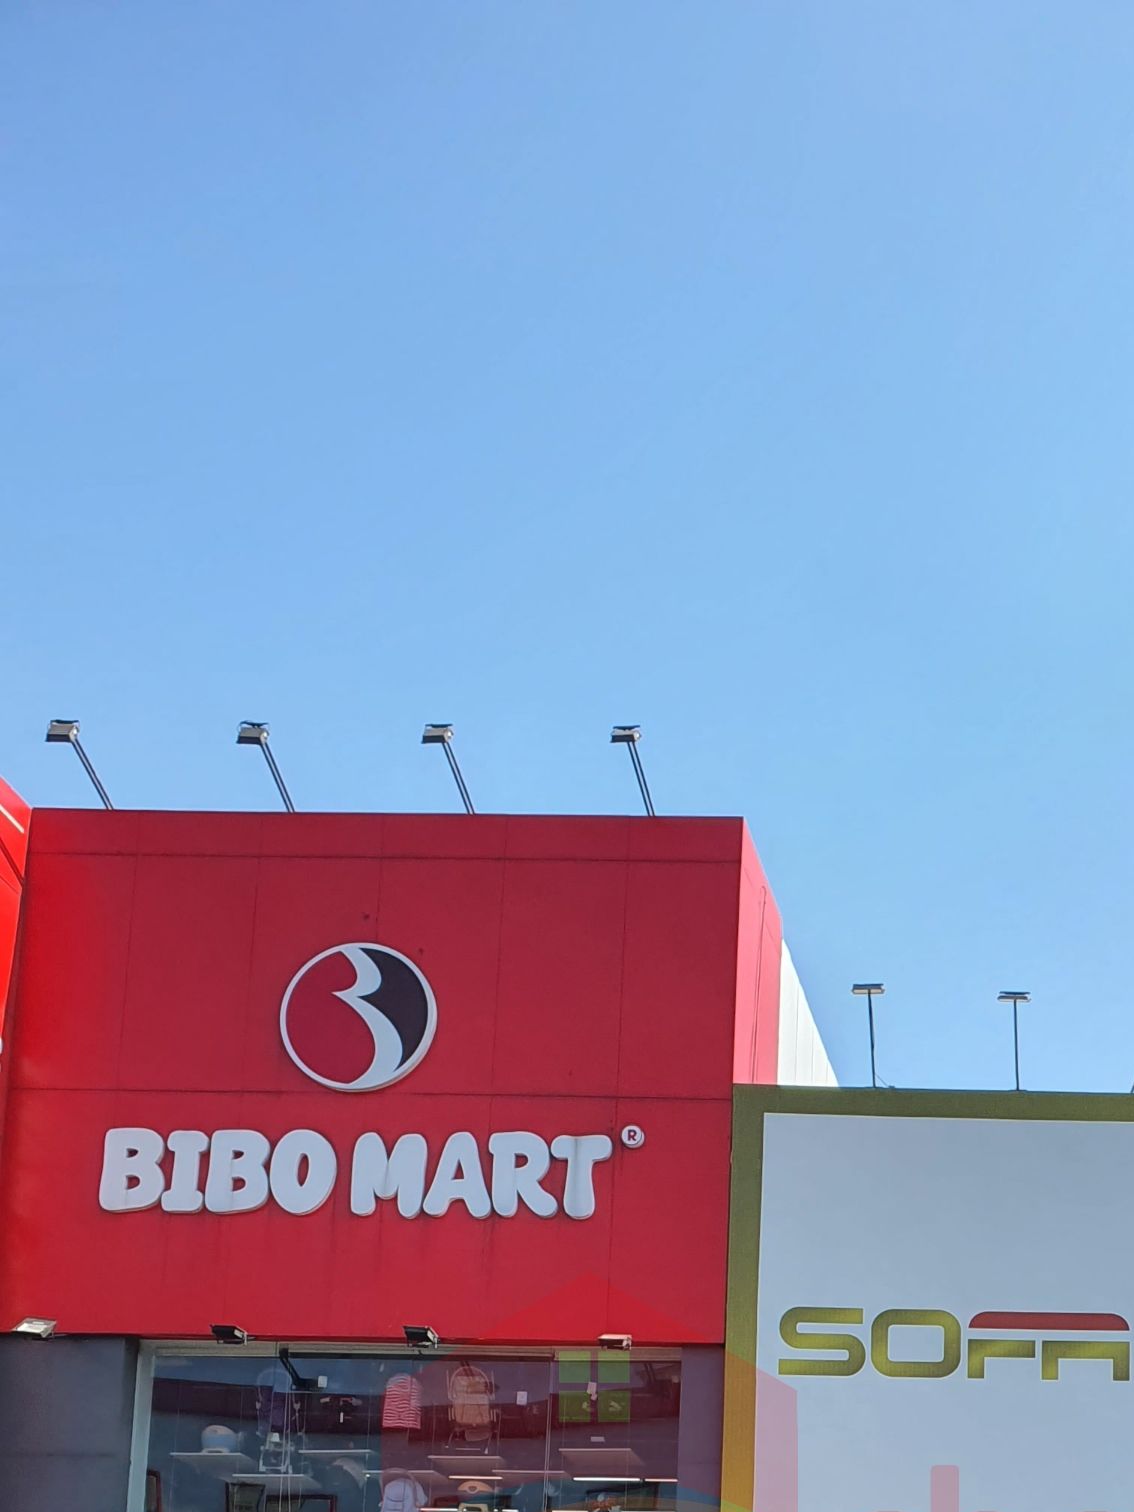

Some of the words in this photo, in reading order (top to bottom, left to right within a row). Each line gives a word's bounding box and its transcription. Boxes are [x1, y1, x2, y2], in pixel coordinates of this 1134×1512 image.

[98, 1127, 338, 1216] BIBO
[350, 1131, 613, 1220] MART
[778, 1306, 1131, 1384] SOFA
